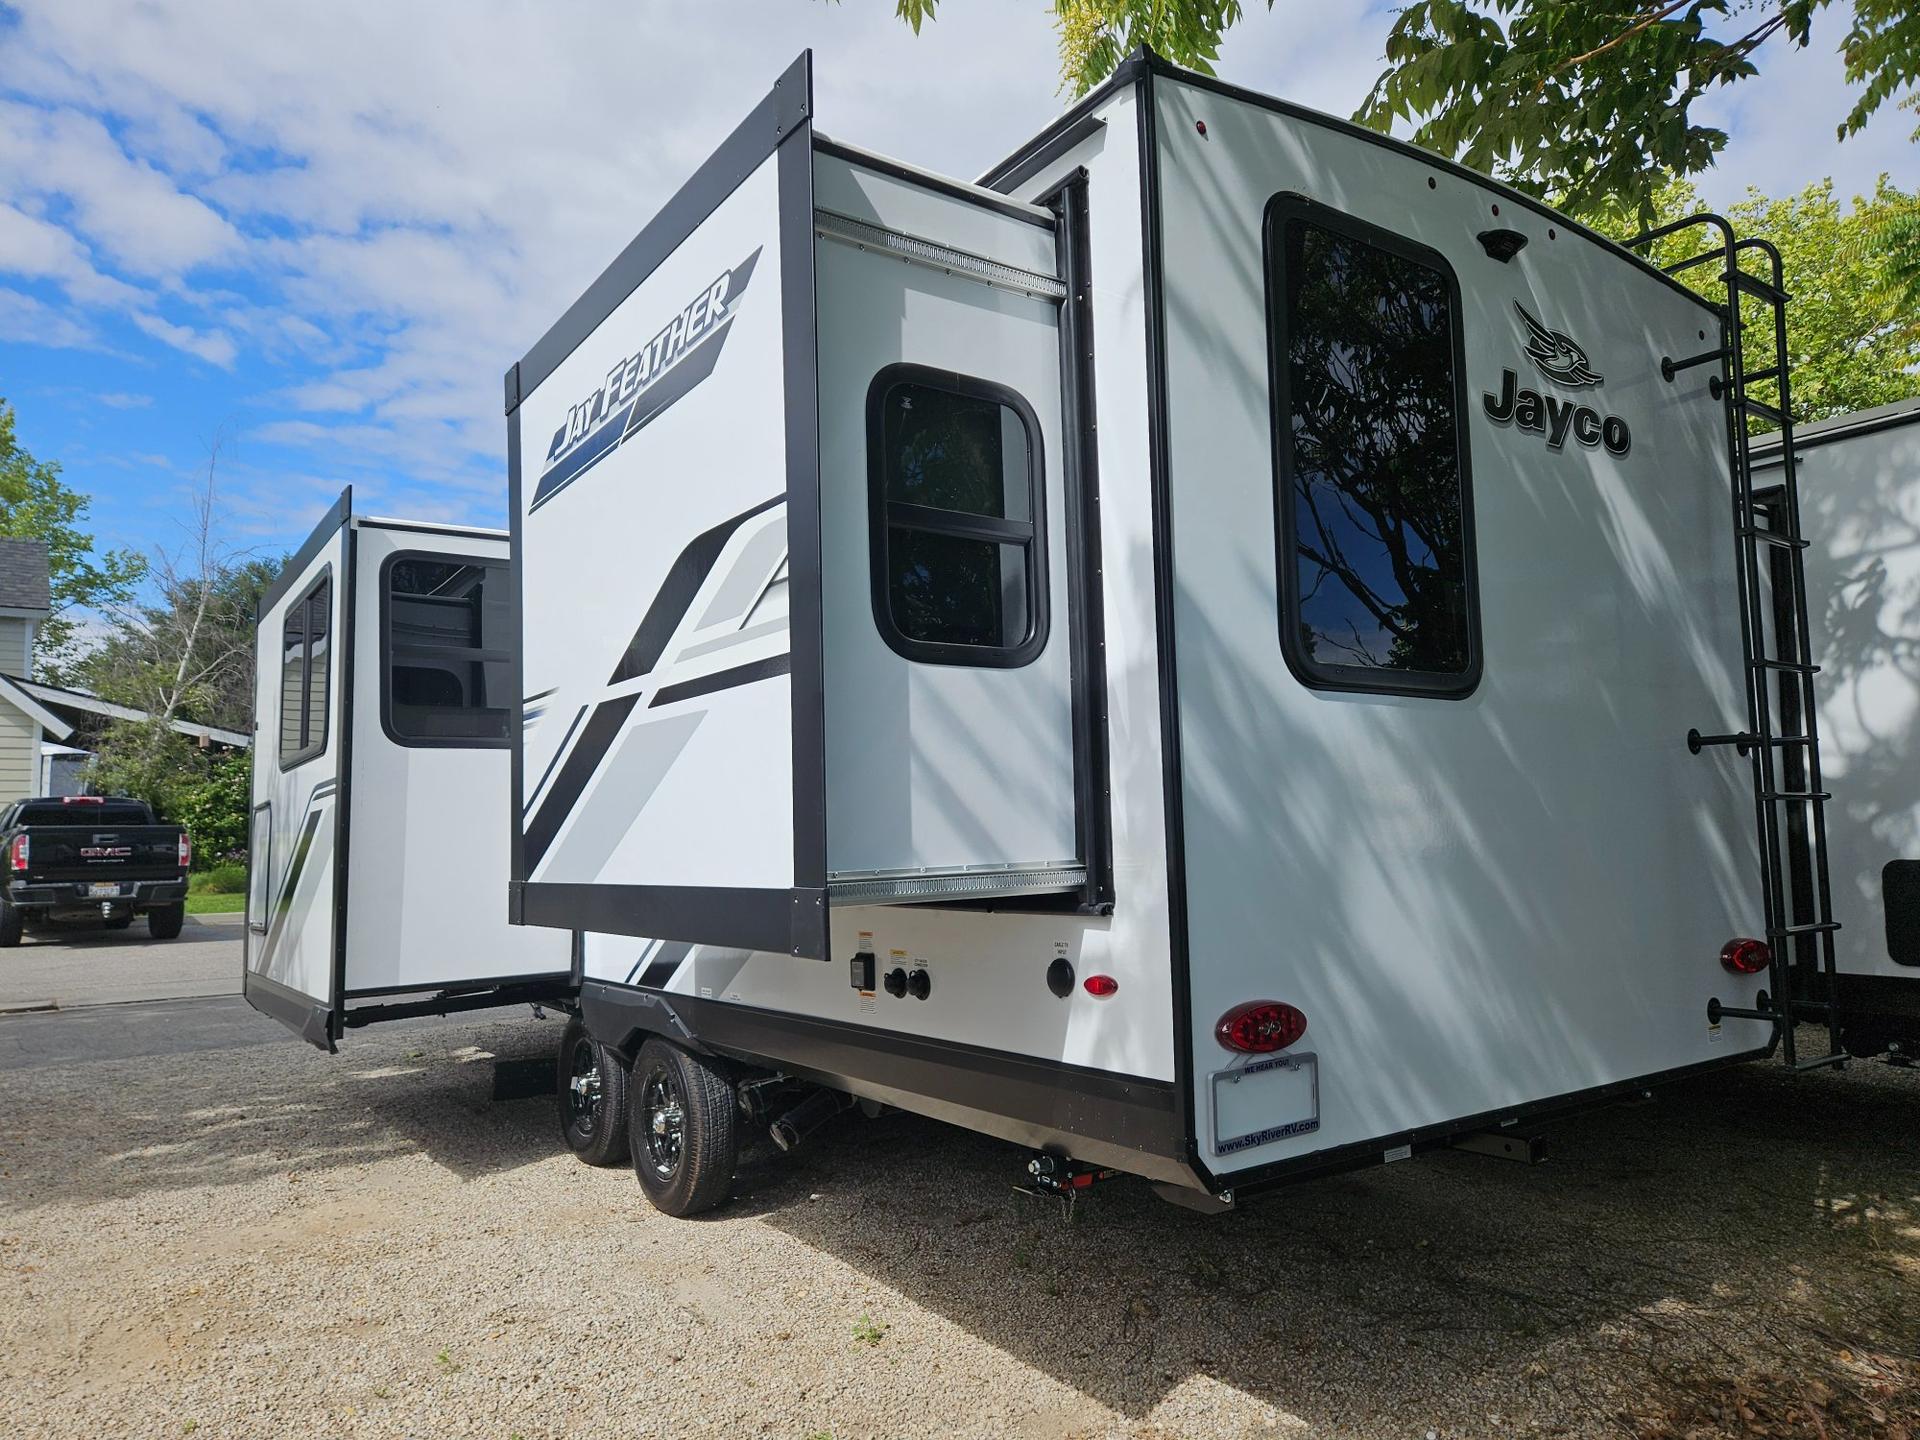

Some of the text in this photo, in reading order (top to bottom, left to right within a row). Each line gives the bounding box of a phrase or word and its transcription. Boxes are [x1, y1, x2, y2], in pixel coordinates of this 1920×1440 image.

[554, 269, 734, 462] JAY FEATHER
[1482, 366, 1631, 453] Jayco
[80, 847, 132, 857] GMC
[1245, 1065, 1255, 1074] WE
[1255, 1062, 1274, 1072] HEAR
[1218, 1120, 1319, 1153] www.SkyRiverRV.com
